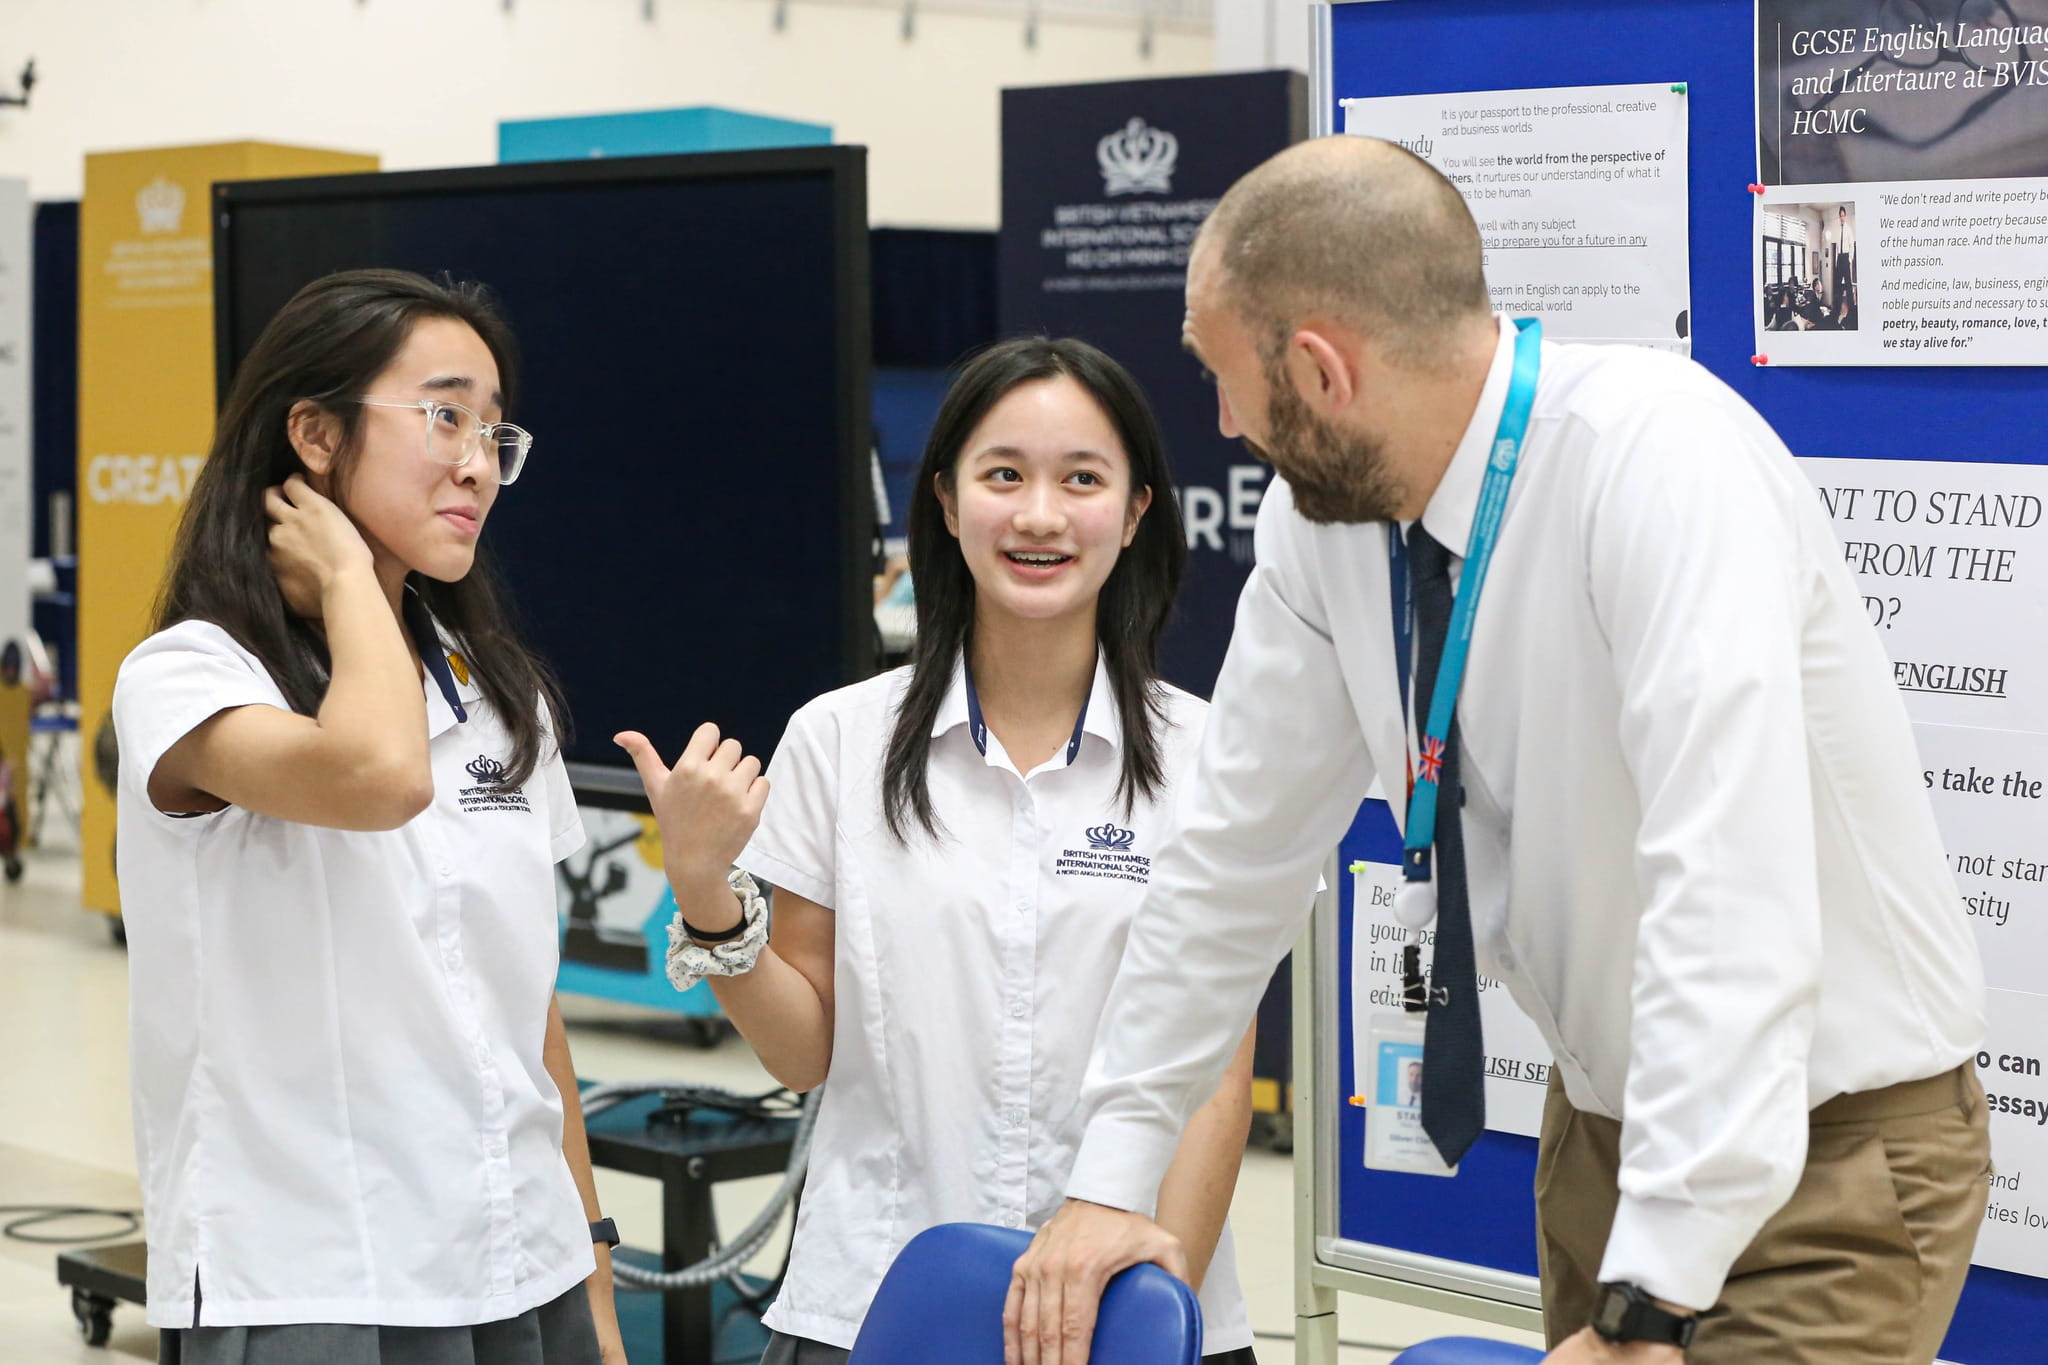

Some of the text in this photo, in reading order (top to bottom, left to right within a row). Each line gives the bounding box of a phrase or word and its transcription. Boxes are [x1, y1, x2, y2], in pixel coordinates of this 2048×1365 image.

[1792, 28, 1857, 56] GCSE
[1863, 23, 1949, 58] English
[1792, 69, 1835, 95] and
[1841, 67, 1957, 94] Litertaure
[1963, 66, 1987, 88] at
[1441, 110, 1448, 120] It
[1449, 110, 1457, 119] is
[1458, 109, 1478, 121] your
[1480, 106, 1520, 120] passport
[1522, 107, 1532, 116] to
[1534, 104, 1549, 116] the
[1616, 100, 1657, 112] creative
[1442, 122, 1534, 136] and business worlds
[1792, 108, 1867, 135] HCMC
[1393, 134, 1433, 159] tudy
[1443, 149, 1666, 168] You will see the world from the perspective of
[1446, 166, 1661, 184] thers, it nurtures our understanding of what it
[1474, 189, 1483, 199] to
[1485, 187, 1497, 198] be
[1900, 192, 1927, 204] don't
[1929, 192, 1951, 204] read
[1953, 191, 1974, 203] and
[1975, 190, 2001, 203] write
[2003, 190, 2038, 204] poetry
[1479, 217, 1577, 231] well with any subject
[1880, 213, 2048, 229] We read and write poetry because
[1502, 236, 1540, 248] prepare
[1542, 236, 1560, 248] you
[1561, 234, 1576, 246] for
[1577, 236, 1583, 245] a
[1585, 233, 1616, 246] future
[1617, 233, 1627, 246] in
[1629, 234, 1648, 247] any
[1880, 236, 1892, 248] of
[1892, 236, 1908, 248] the
[1910, 235, 1945, 248] human
[1947, 235, 1971, 247] race.
[1973, 233, 1994, 246] And
[1995, 233, 2012, 246] the
[1881, 256, 1944, 269] with passion.
[1488, 281, 1640, 298] learn in English can apply to the
[1881, 279, 1901, 291] And
[1902, 278, 1950, 292] medicine,
[1952, 278, 1972, 291] law,
[1974, 276, 2021, 291] business,
[1505, 299, 1545, 311] medical
[1546, 299, 1573, 311] world
[1882, 298, 1909, 310] noble
[1911, 297, 1951, 311] pursuits
[1953, 296, 1972, 309] and
[1974, 298, 2025, 311] necessary
[2027, 297, 2038, 309] to
[1882, 317, 1919, 331] poetry,
[1921, 317, 1959, 331] beauty,
[1962, 319, 2012, 331] romance,
[2014, 316, 2040, 329] love,
[1883, 339, 1898, 348] we
[1900, 337, 1921, 350] stay
[1923, 336, 1948, 348] alive
[1171, 465, 1266, 551] RE
[1872, 490, 1917, 523] TO
[1925, 491, 2042, 528] STAND
[1843, 541, 2016, 582] FROM THE
[1893, 661, 2008, 698] ENGLISH
[1942, 766, 1995, 794] take
[2002, 771, 2043, 799] the
[1056, 859, 1123, 871] INTERNATIONAL
[1063, 849, 1150, 866] BRITISH VIETNAMESE
[1957, 854, 1996, 876] not
[1080, 870, 1102, 878] ANGLIA
[1961, 891, 2010, 926] sity
[1370, 950, 1386, 973] in
[1976, 1051, 2040, 1076] o can
[1396, 1111, 1422, 1122] STA
[1986, 1093, 2048, 1125] essay
[1989, 1171, 2021, 1191] and
[1987, 1202, 2018, 1224] ties
